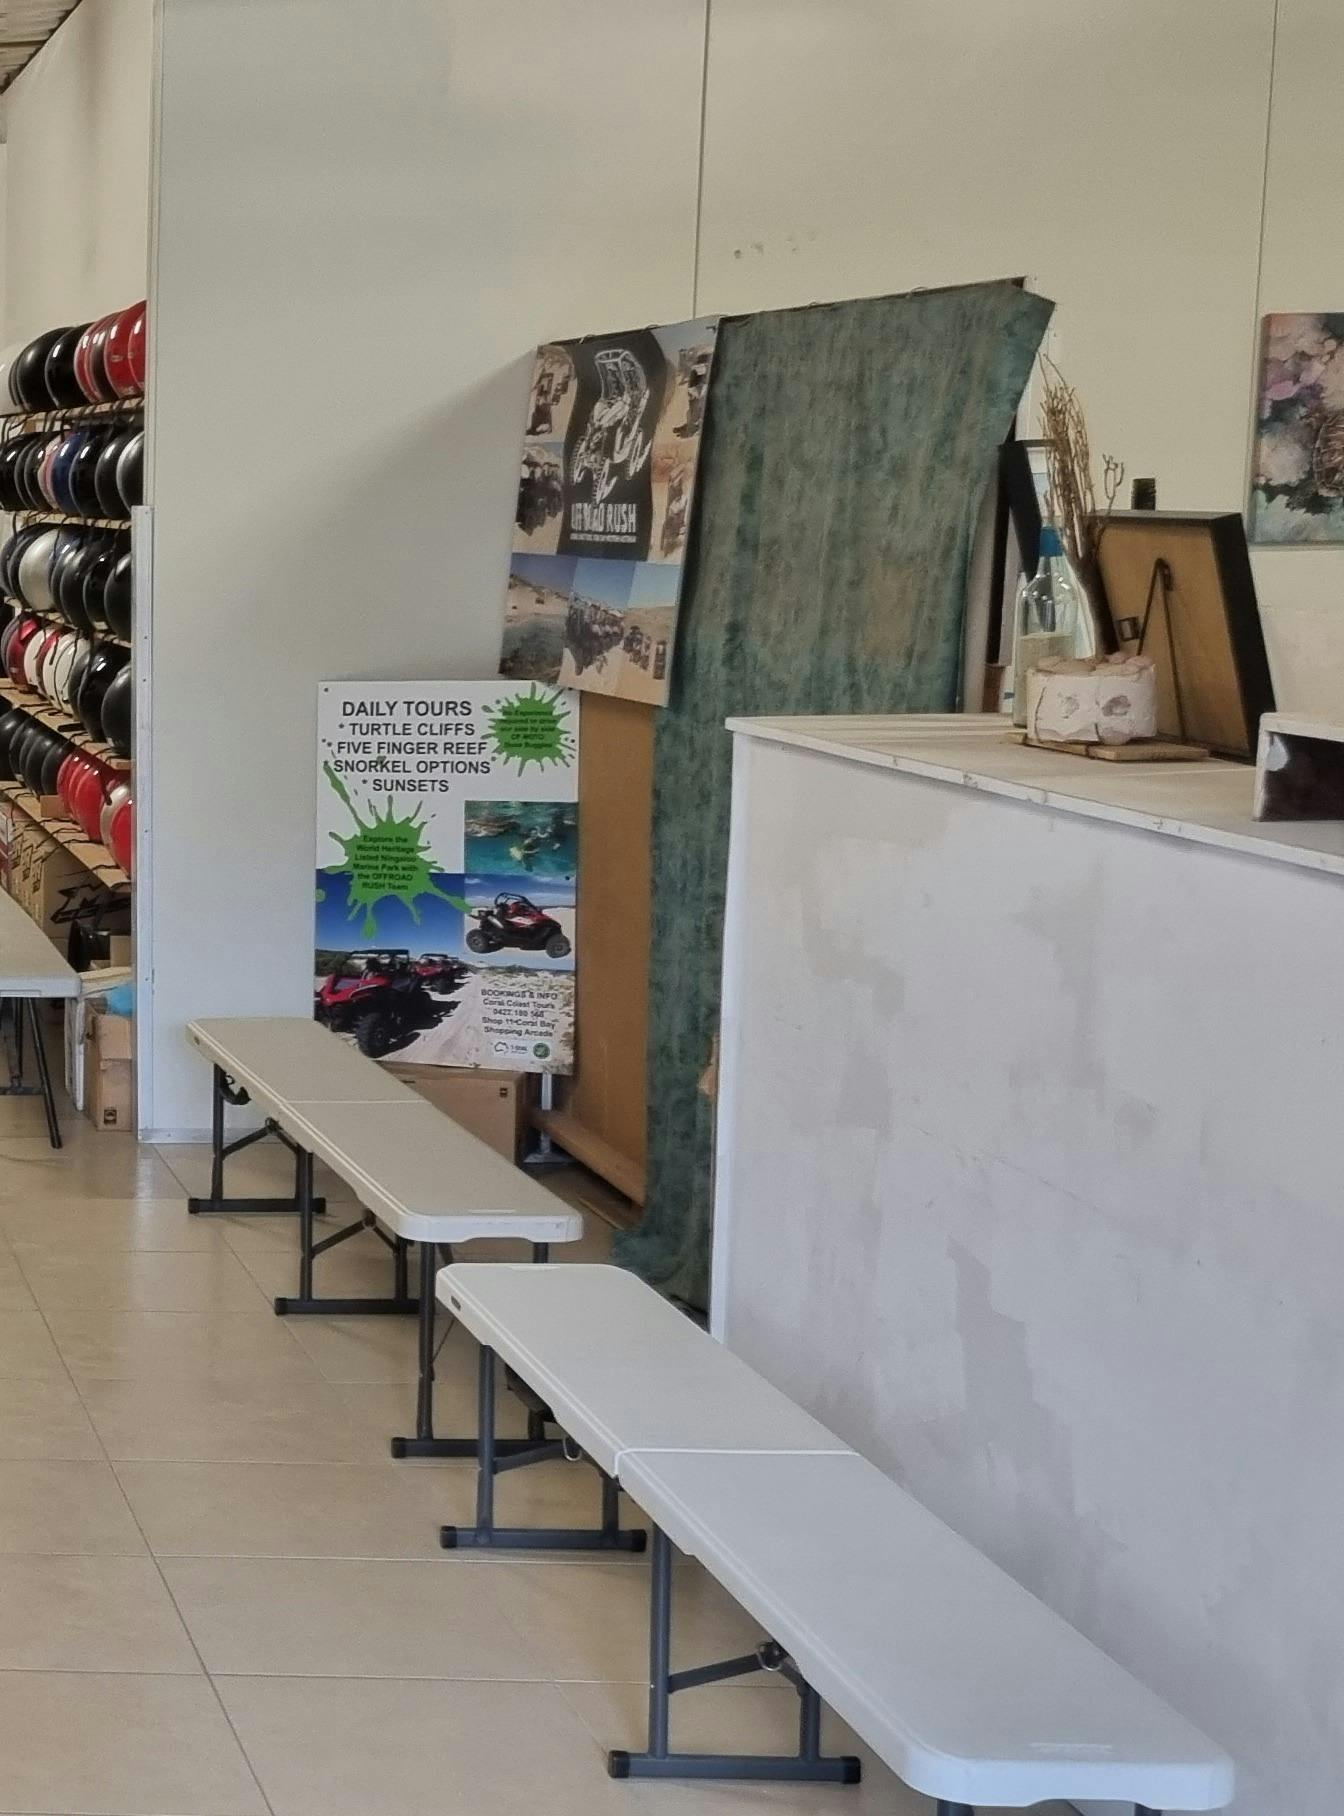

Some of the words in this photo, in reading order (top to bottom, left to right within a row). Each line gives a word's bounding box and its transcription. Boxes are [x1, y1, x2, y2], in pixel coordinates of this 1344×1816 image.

[342, 701, 398, 717] DAILY
[402, 700, 472, 717] TOURS
[349, 723, 412, 736] TURTLE
[417, 723, 475, 736] CLIFFS
[337, 741, 372, 754] FIVE
[377, 741, 438, 755] FINGER
[443, 742, 488, 755] REEF
[333, 760, 412, 774] SNORKEL
[416, 760, 491, 775] OPTIONS
[372, 778, 449, 793] SUNSETS
